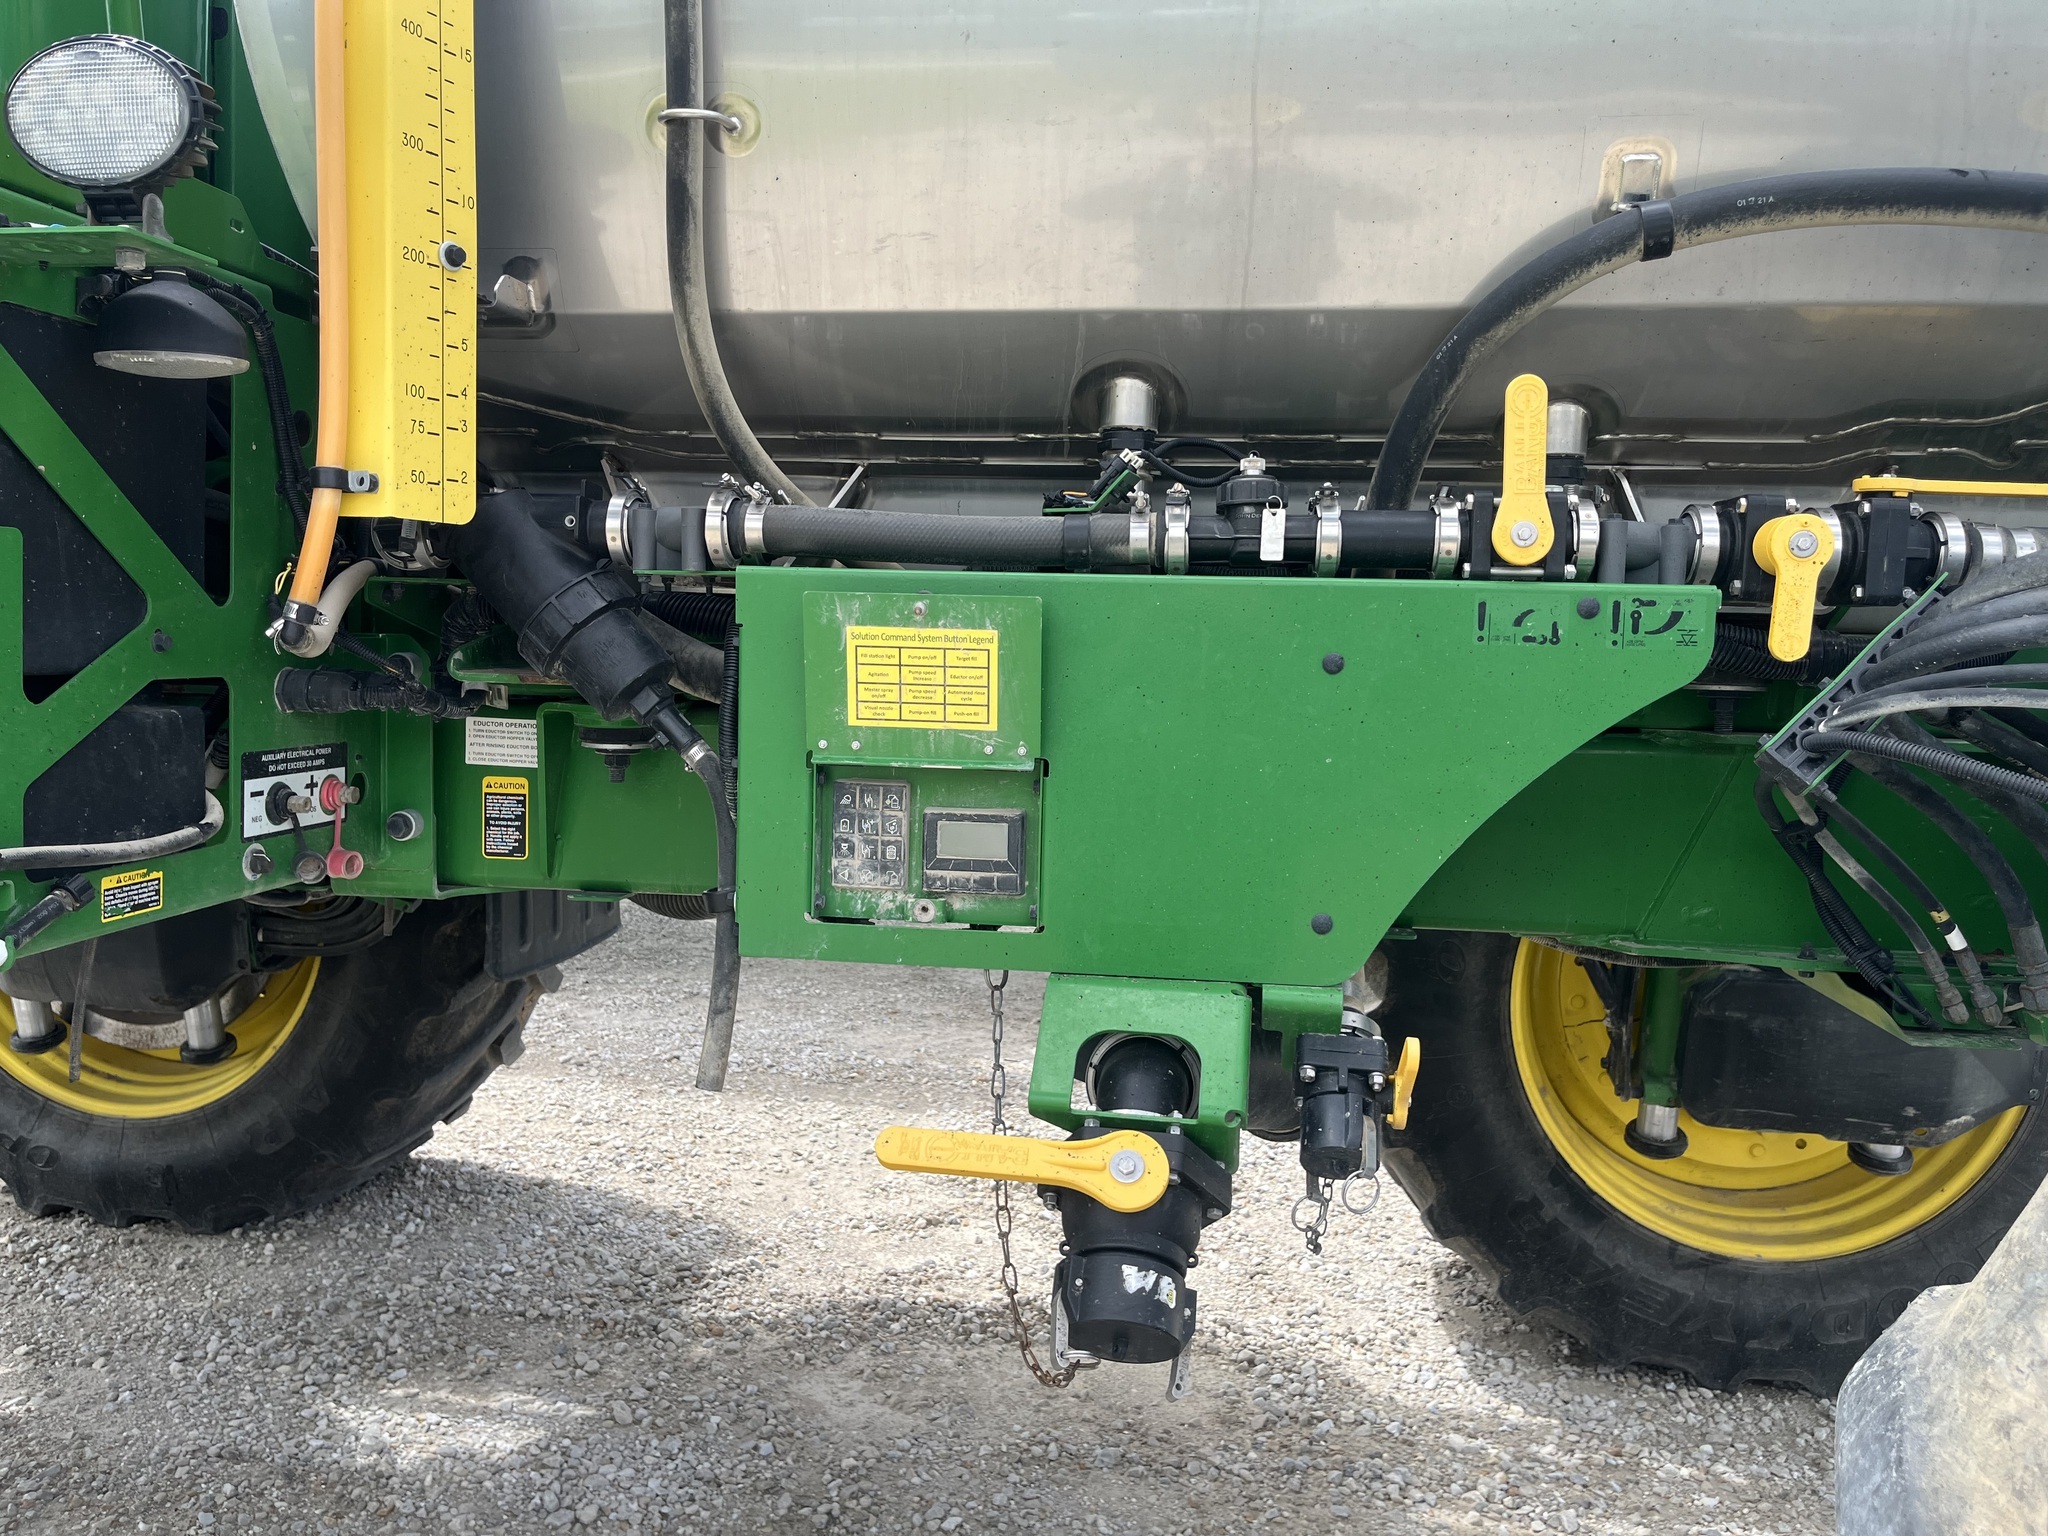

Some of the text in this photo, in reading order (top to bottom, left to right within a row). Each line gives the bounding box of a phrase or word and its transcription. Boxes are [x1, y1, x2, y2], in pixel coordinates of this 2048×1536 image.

[401, 18, 422, 38] 400
[461, 46, 472, 63] 15
[402, 132, 423, 151] 300
[462, 194, 474, 209] 10
[403, 246, 424, 264] 200
[461, 339, 468, 351] 5
[406, 383, 425, 398] 100
[461, 387, 467, 400] 4
[411, 419, 425, 434] 75
[461, 420, 468, 432] 3
[411, 470, 425, 484] 50
[461, 471, 468, 484] 2
[851, 632, 994, 645] Solution Command System Button Legend
[261, 752, 286, 762] AUXILIARY
[287, 749, 314, 758] ELECTRICAL
